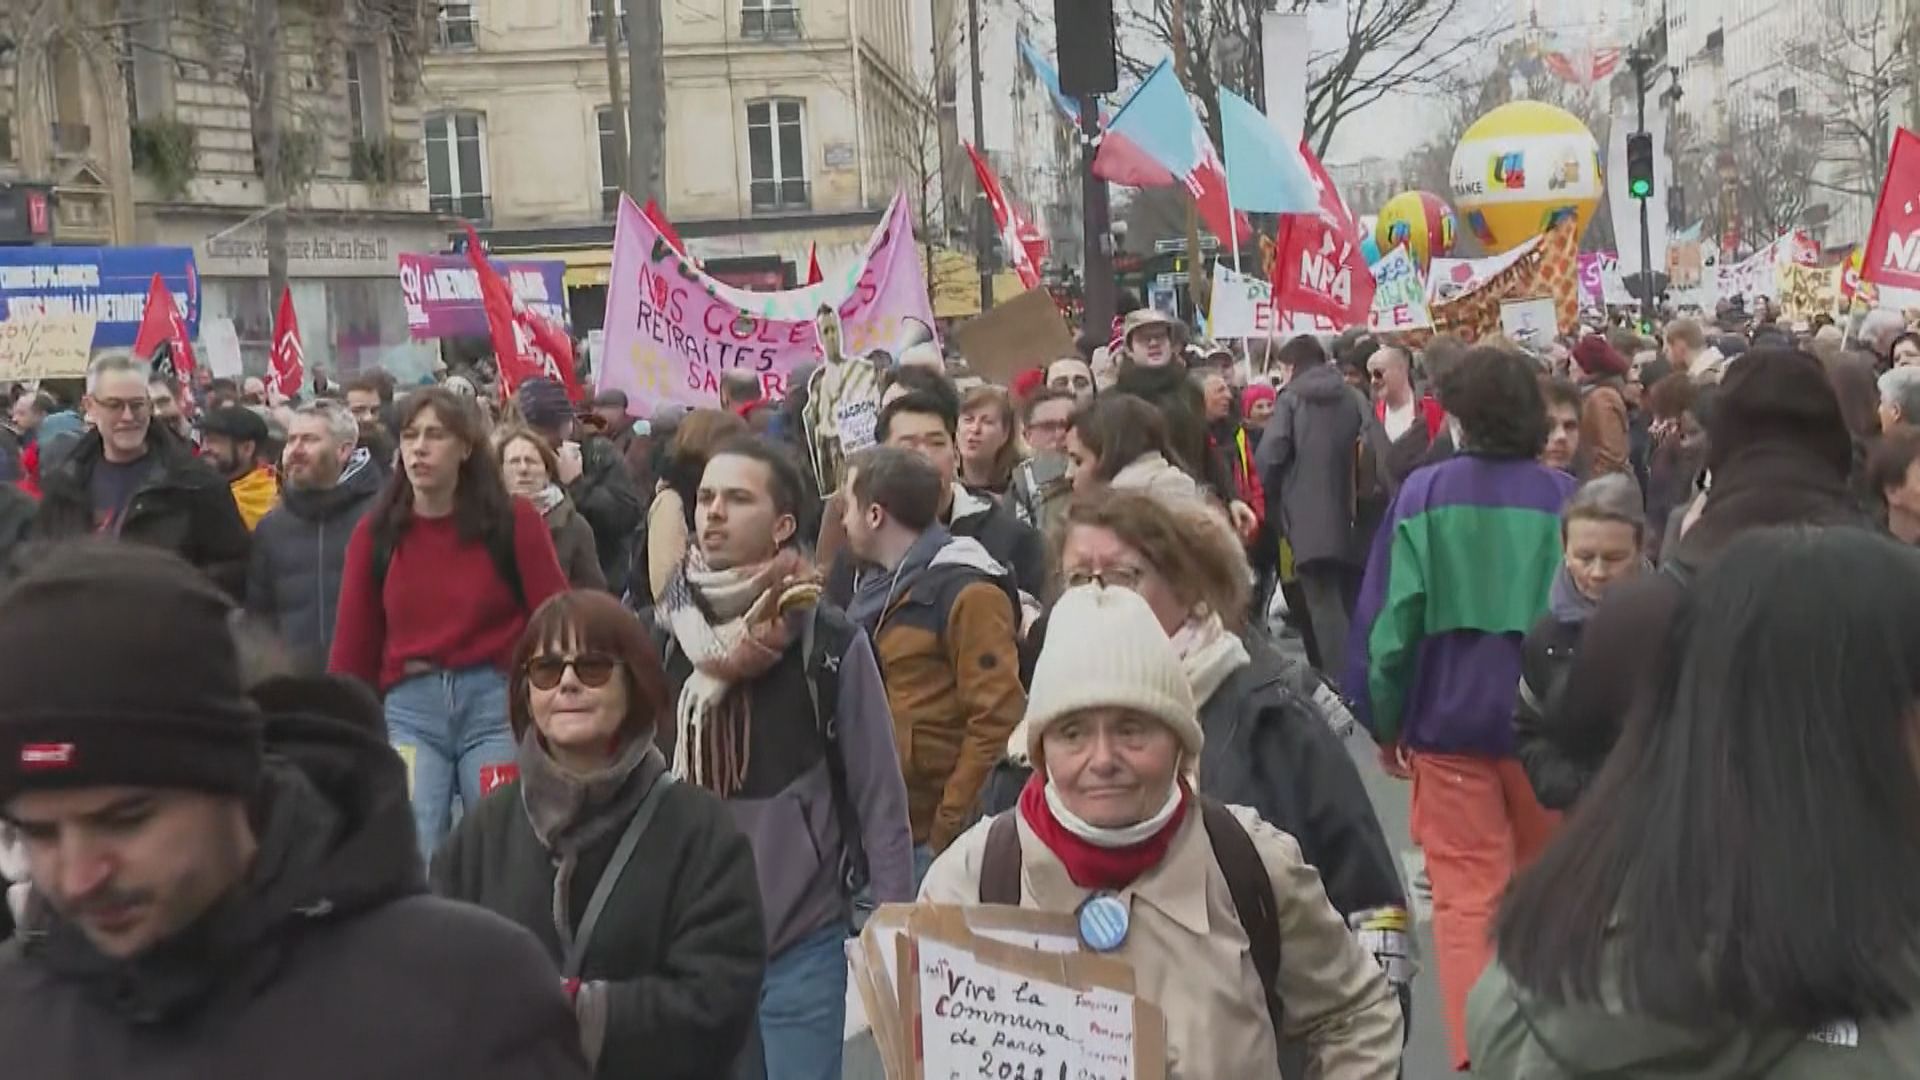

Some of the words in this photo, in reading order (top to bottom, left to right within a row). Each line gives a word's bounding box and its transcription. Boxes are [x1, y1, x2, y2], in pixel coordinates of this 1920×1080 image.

[1301, 250, 1352, 308] NPA
[637, 299, 776, 371] RETRAITES
[948, 969, 996, 1002] Vive
[935, 994, 1072, 1041] Commune
[950, 1027, 977, 1046] de
